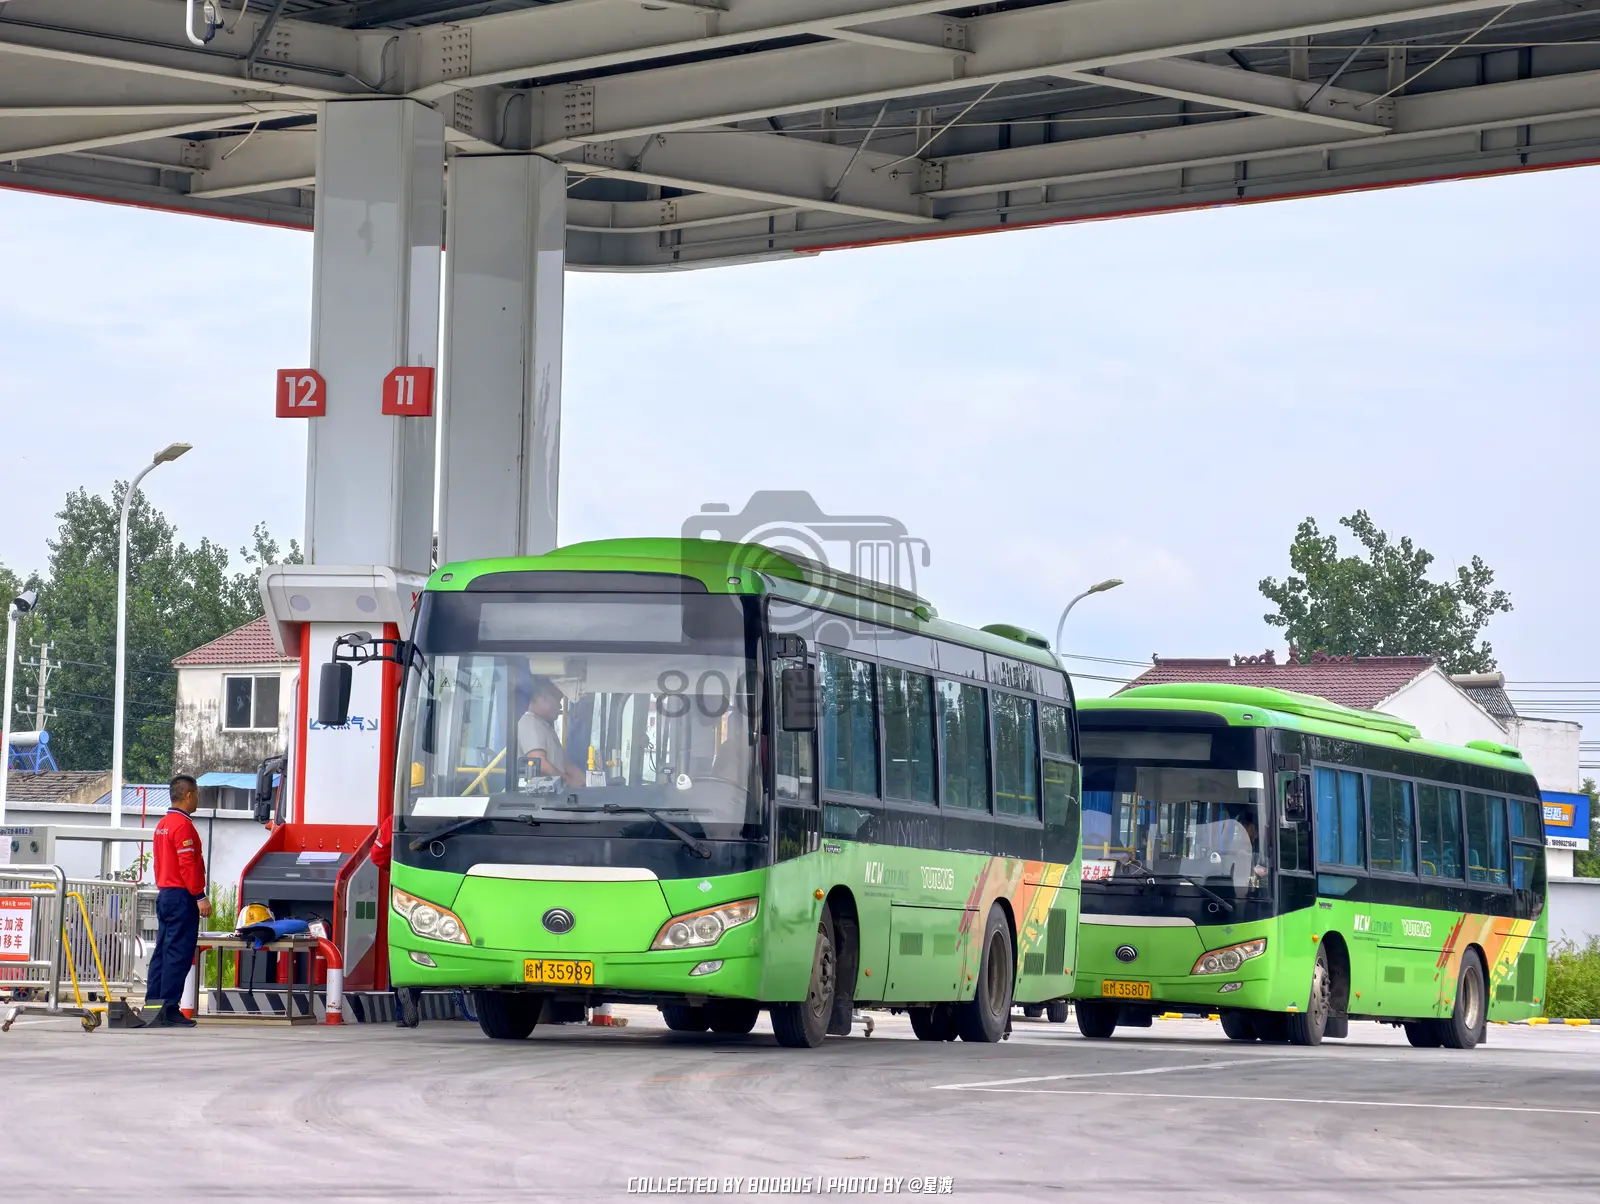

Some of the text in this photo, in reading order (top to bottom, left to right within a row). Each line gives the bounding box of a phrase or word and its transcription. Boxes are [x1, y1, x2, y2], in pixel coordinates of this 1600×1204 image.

[285, 375, 317, 407] 12
[395, 375, 414, 405] 11
[864, 861, 884, 884] NEW
[920, 866, 955, 891] YUTONG
[1354, 914, 1371, 931] NEW
[1401, 918, 1432, 938] YUTONG
